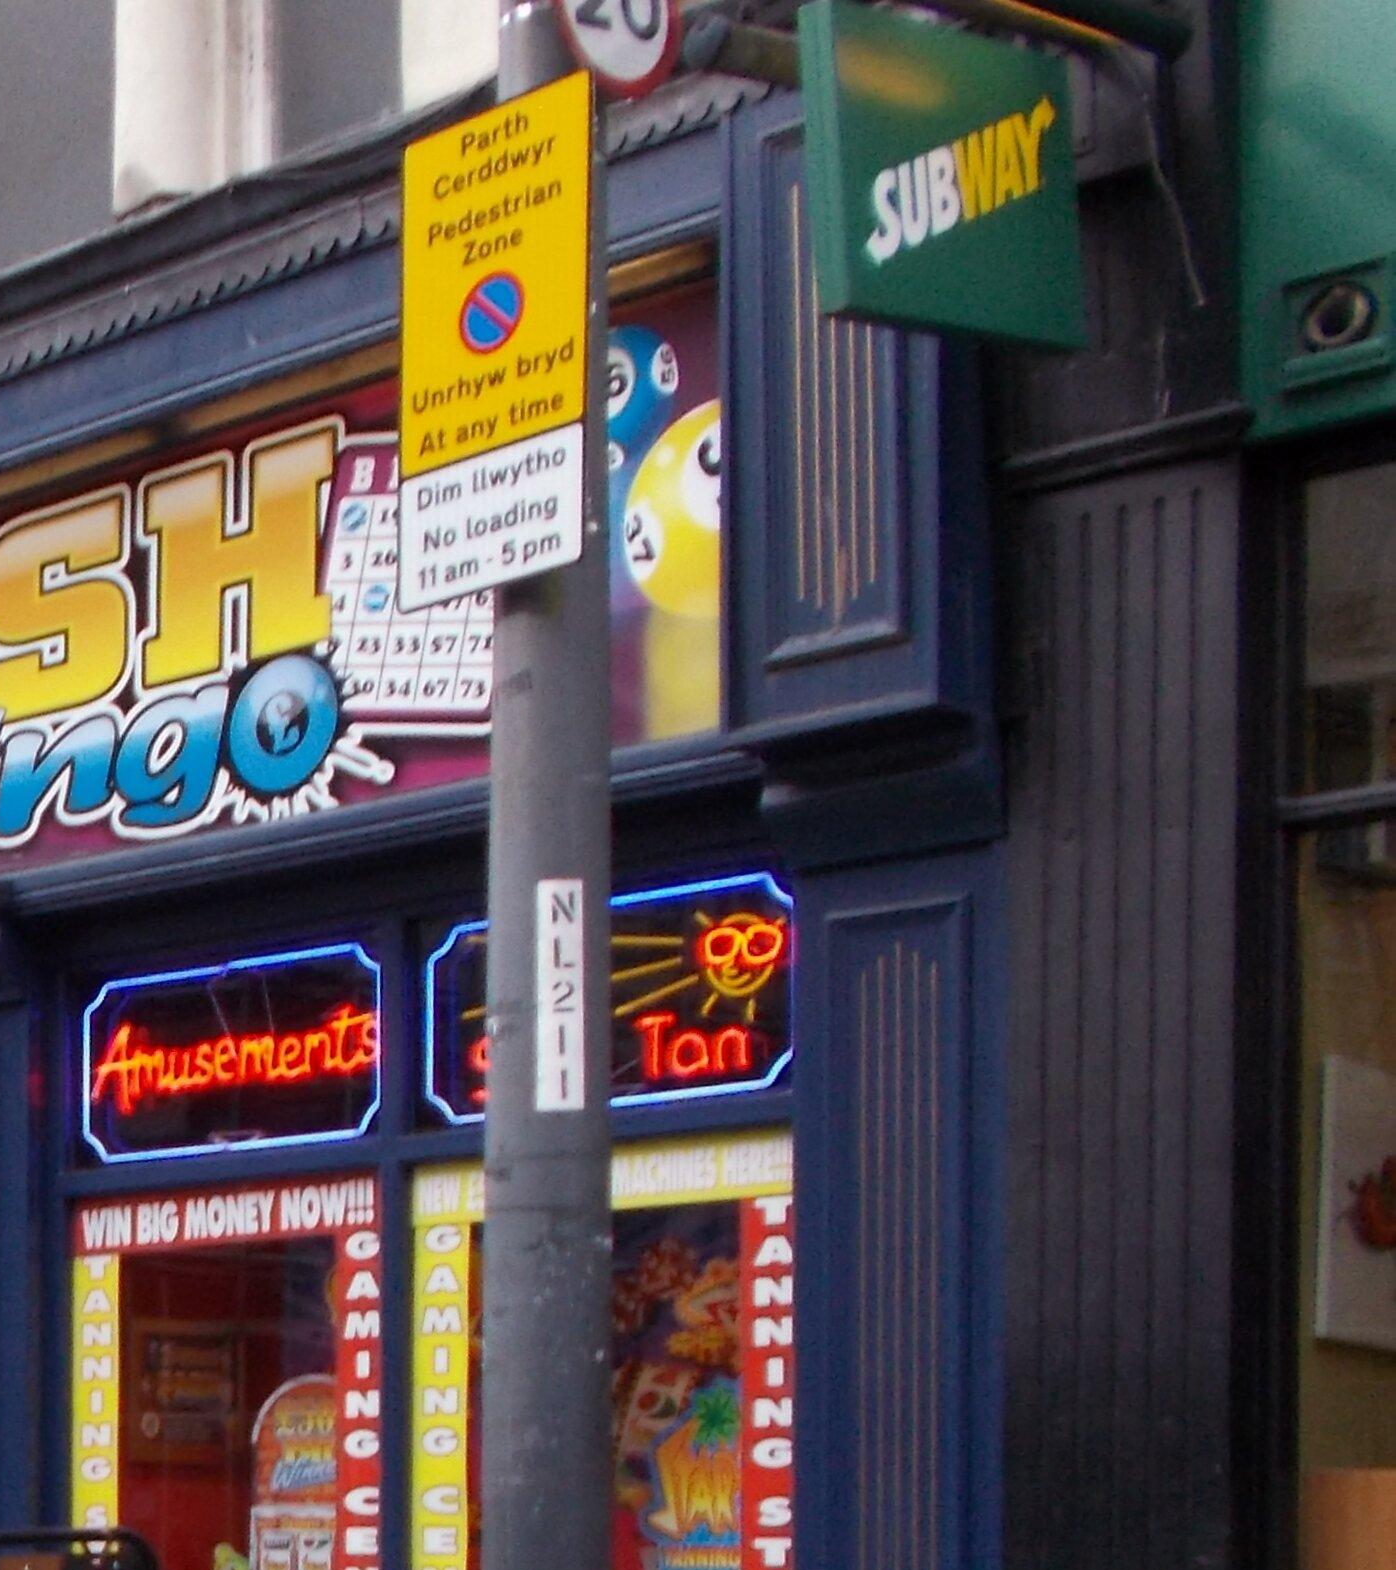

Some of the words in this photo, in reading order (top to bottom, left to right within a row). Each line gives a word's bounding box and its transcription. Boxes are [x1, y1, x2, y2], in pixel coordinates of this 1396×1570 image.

[432, 134, 556, 200] Cerddwyr
[459, 112, 529, 157] Parth
[427, 177, 562, 248] Pedestrian
[865, 96, 1055, 265] SUBWAY
[462, 228, 523, 267] Zone
[411, 365, 507, 416] Unrhyw
[516, 338, 576, 381] bryd
[418, 428, 446, 457] At
[455, 420, 498, 449] any
[509, 391, 564, 428] time
[418, 477, 463, 512] Dim
[472, 445, 568, 493] llwytho
[423, 523, 457, 553] No
[466, 495, 559, 541] loading
[92, 1003, 378, 1117] Amusements
[632, 1011, 753, 1082] Tan
[611, 1145, 718, 1197] MACHINES
[82, 1203, 134, 1251] WIN
[136, 1197, 180, 1246] BIG
[184, 1189, 275, 1241] MONEY
[280, 1177, 376, 1232] NOW!!!
